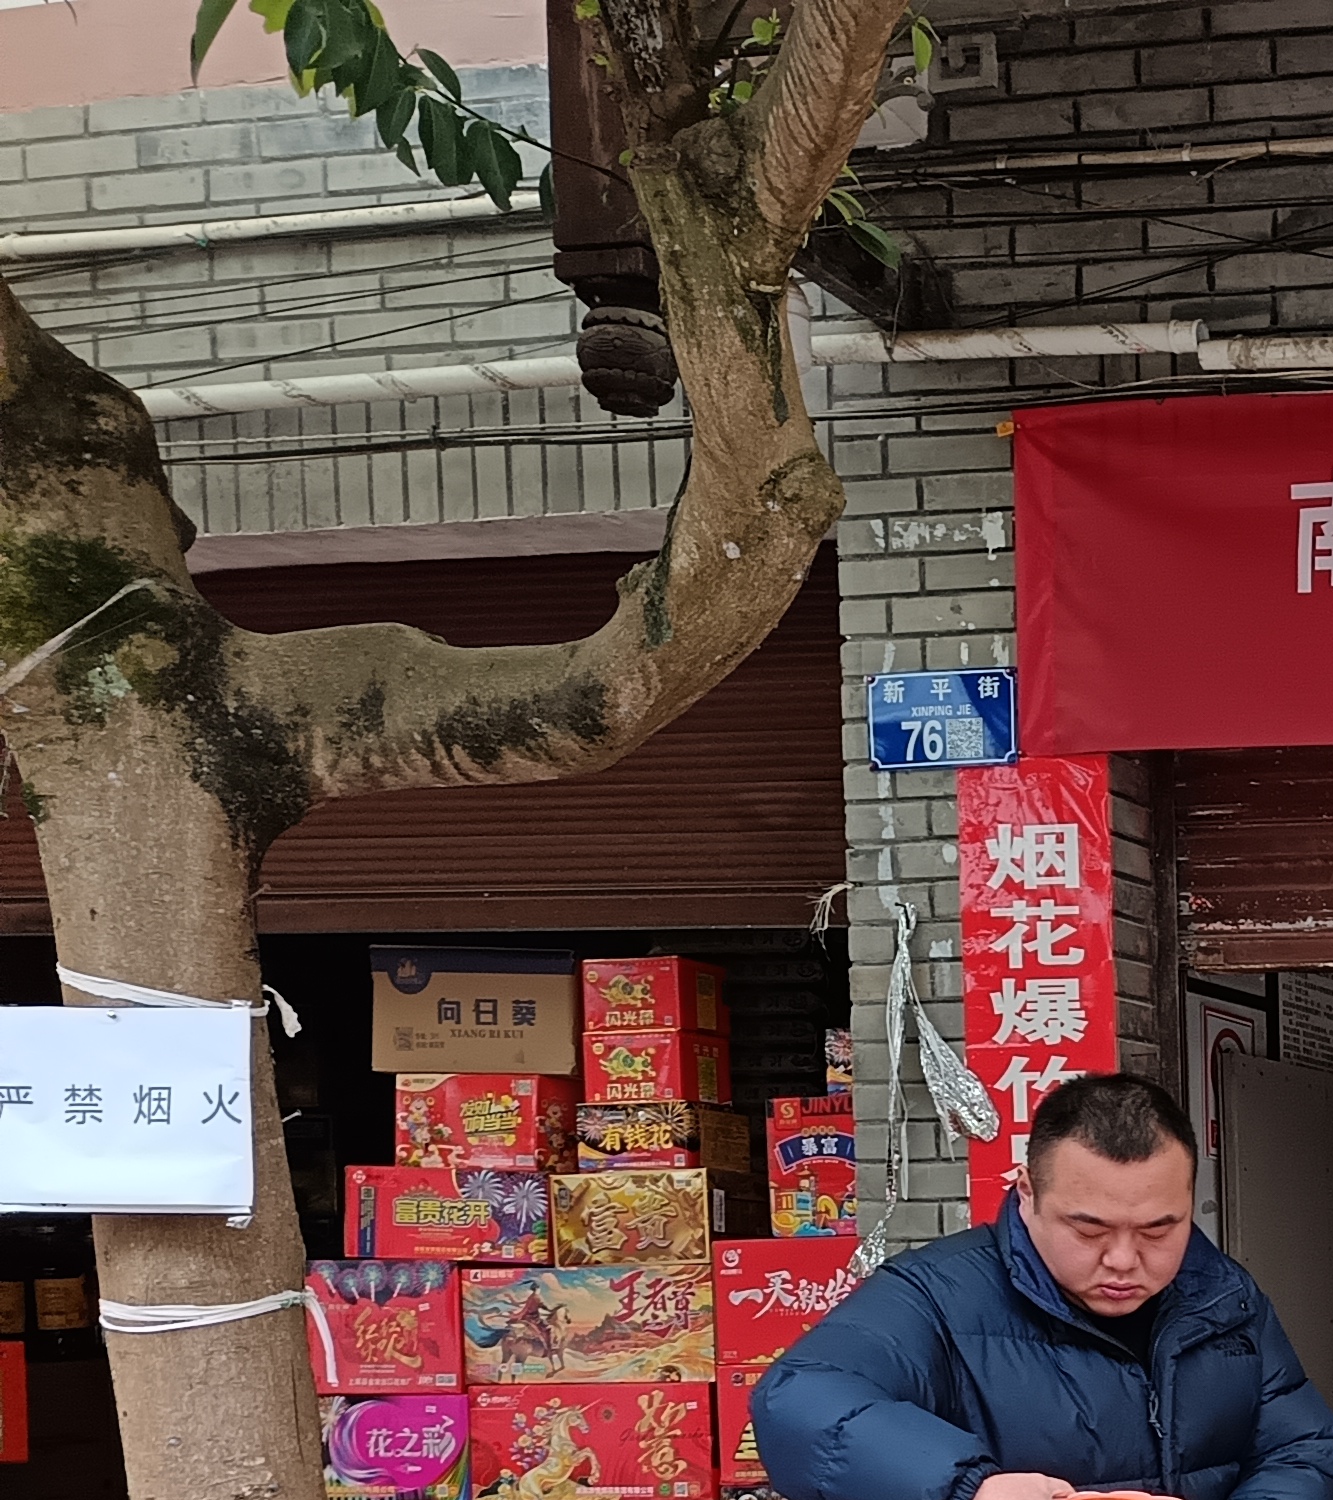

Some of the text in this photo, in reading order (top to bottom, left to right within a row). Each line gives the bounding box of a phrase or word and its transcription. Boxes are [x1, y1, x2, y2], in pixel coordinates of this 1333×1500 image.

[882, 676, 1000, 704] 新平街
[911, 704, 972, 717] XINPING JIE
[901, 720, 943, 762] 76
[437, 998, 537, 1026] 向日葵
[986, 822, 1090, 1192] 烟花爆竹
[450, 1029, 524, 1039] XIANG RI KUI
[0, 1084, 242, 1125] 严禁烟火
[599, 1123, 674, 1151] 有钱花
[393, 1199, 492, 1227] 富贵花开
[366, 1414, 456, 1464] 花之彩
